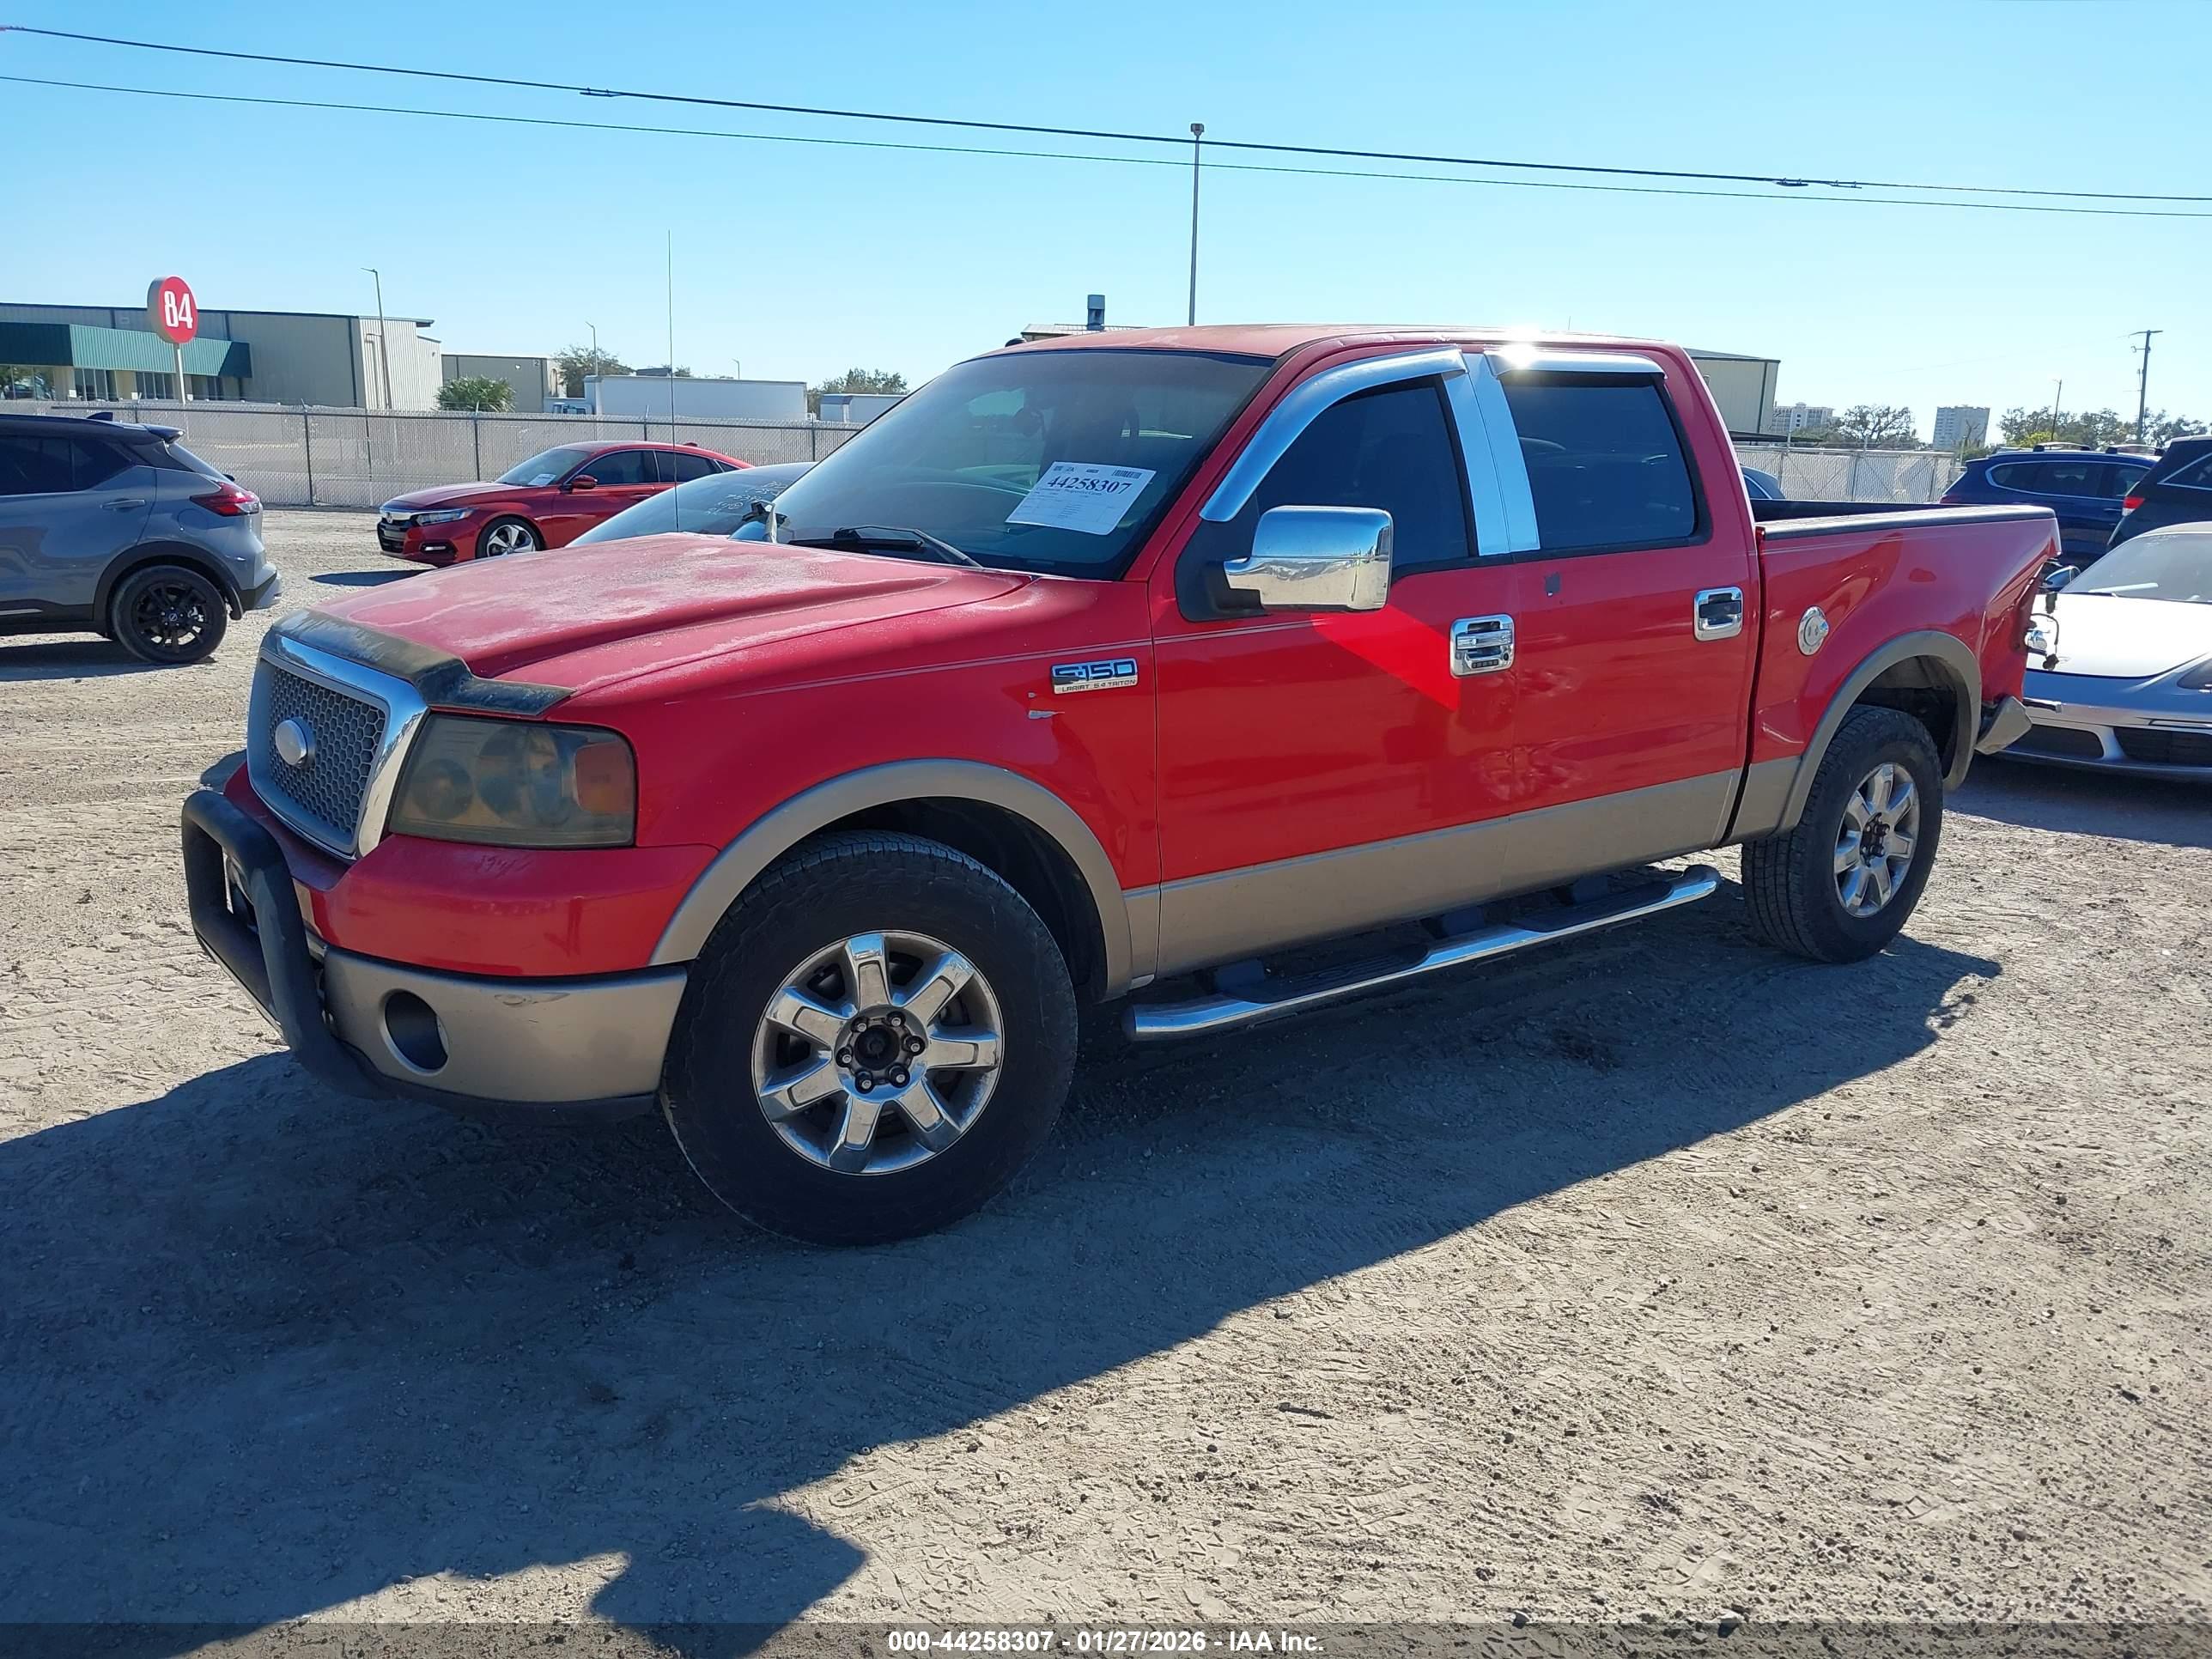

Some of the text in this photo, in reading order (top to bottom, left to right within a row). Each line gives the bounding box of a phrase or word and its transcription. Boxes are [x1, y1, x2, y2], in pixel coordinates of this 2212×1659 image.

[164, 290, 193, 329] 84
[1048, 476, 1133, 495] 44258307
[1061, 684, 1091, 692] LARIAT
